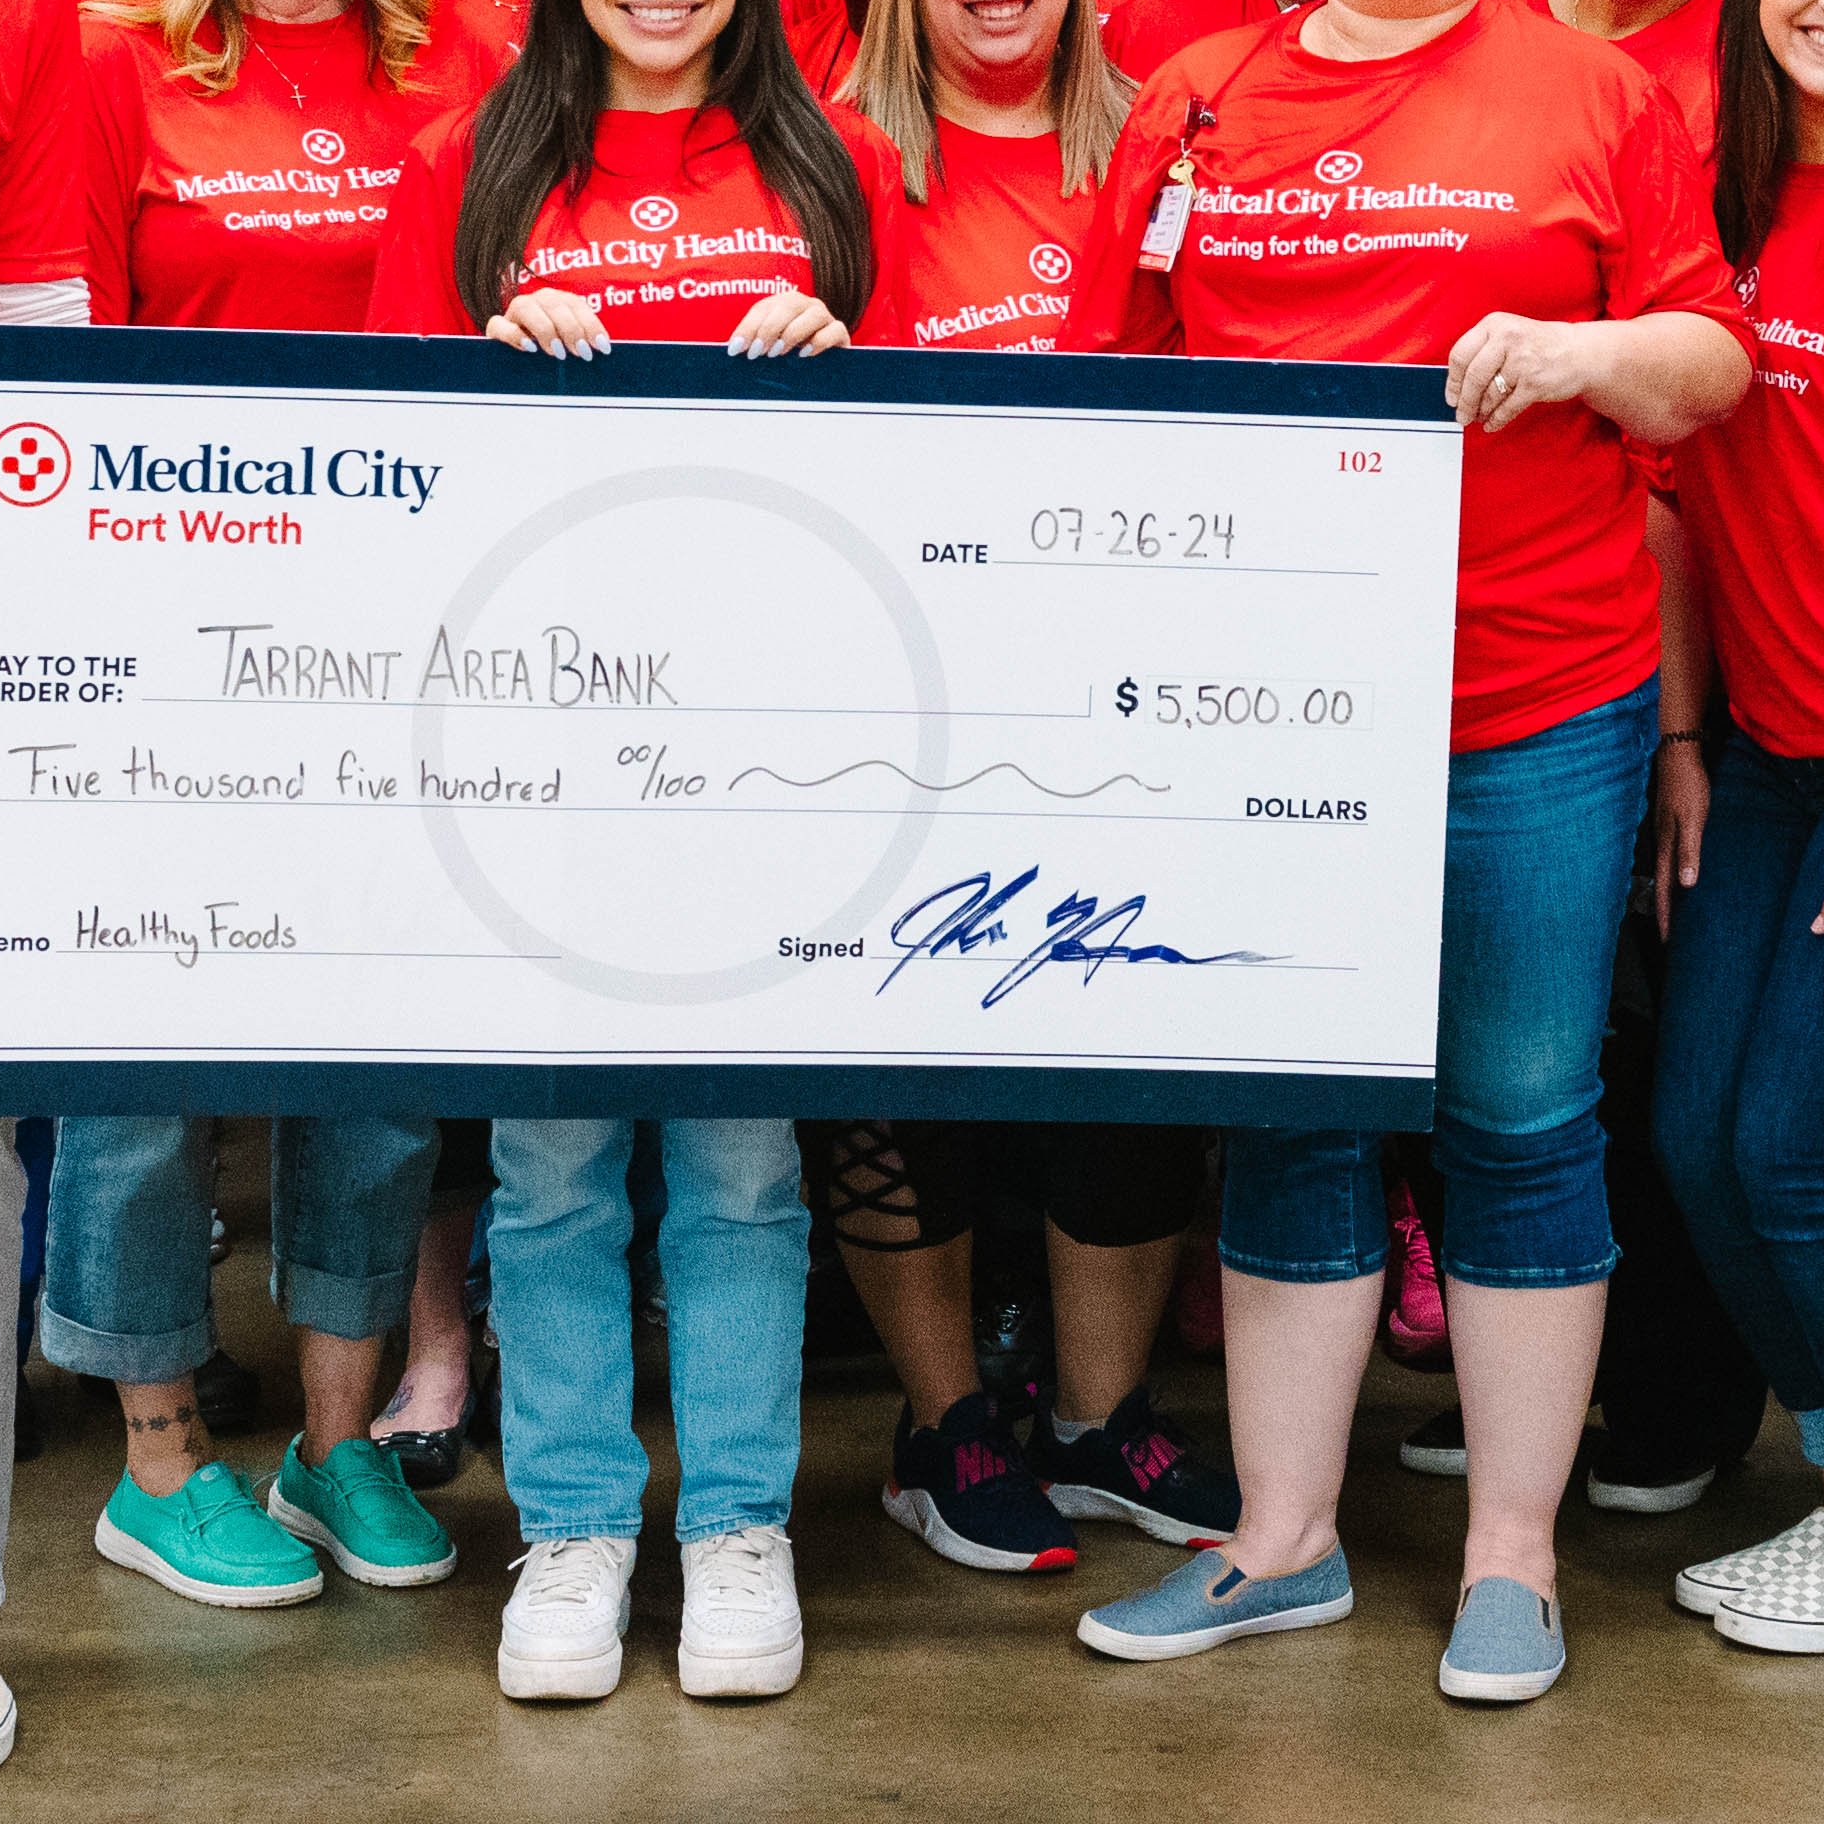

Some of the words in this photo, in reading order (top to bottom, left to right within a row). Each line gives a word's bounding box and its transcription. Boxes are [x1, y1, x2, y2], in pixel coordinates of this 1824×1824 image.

[174, 168, 287, 202] Medical
[287, 168, 341, 197] City
[1277, 187, 1339, 219] City
[1345, 182, 1514, 212] Healthcare
[225, 209, 292, 231] Caring
[293, 209, 320, 226] for
[323, 208, 356, 224] the
[604, 240, 667, 269] City
[673, 227, 811, 259] Healthca
[1199, 234, 1264, 260] Caring
[1268, 234, 1300, 256] for
[1304, 233, 1338, 255] the
[1343, 226, 1469, 252] Community
[605, 285, 635, 307] for
[639, 284, 674, 303] the
[914, 295, 1022, 346] Medical
[1019, 292, 1070, 320] City
[1031, 334, 1056, 351] for
[90, 443, 315, 497] Medical
[327, 449, 443, 512] City
[1336, 448, 1384, 475] 102
[88, 508, 167, 542] Fort
[181, 511, 303, 545] Worth
[1030, 506, 1236, 560] 07-26-24
[922, 542, 989, 566] DATE
[38, 656, 77, 678] TO
[84, 656, 137, 678] THE
[197, 624, 403, 702] TARRANT
[421, 623, 533, 703] AREA
[542, 626, 678, 709] BANK
[76, 681, 123, 704] OF:
[1114, 677, 1139, 719] $
[1155, 683, 1354, 730] 5,500.00
[8, 743, 102, 798] Five
[121, 744, 304, 801] thousand
[336, 749, 398, 802] five
[420, 758, 561, 804] hundred
[1244, 797, 1369, 822] DOLLARS
[76, 904, 200, 968] Healthy
[205, 901, 298, 951] Foods
[777, 934, 864, 963] Signed
